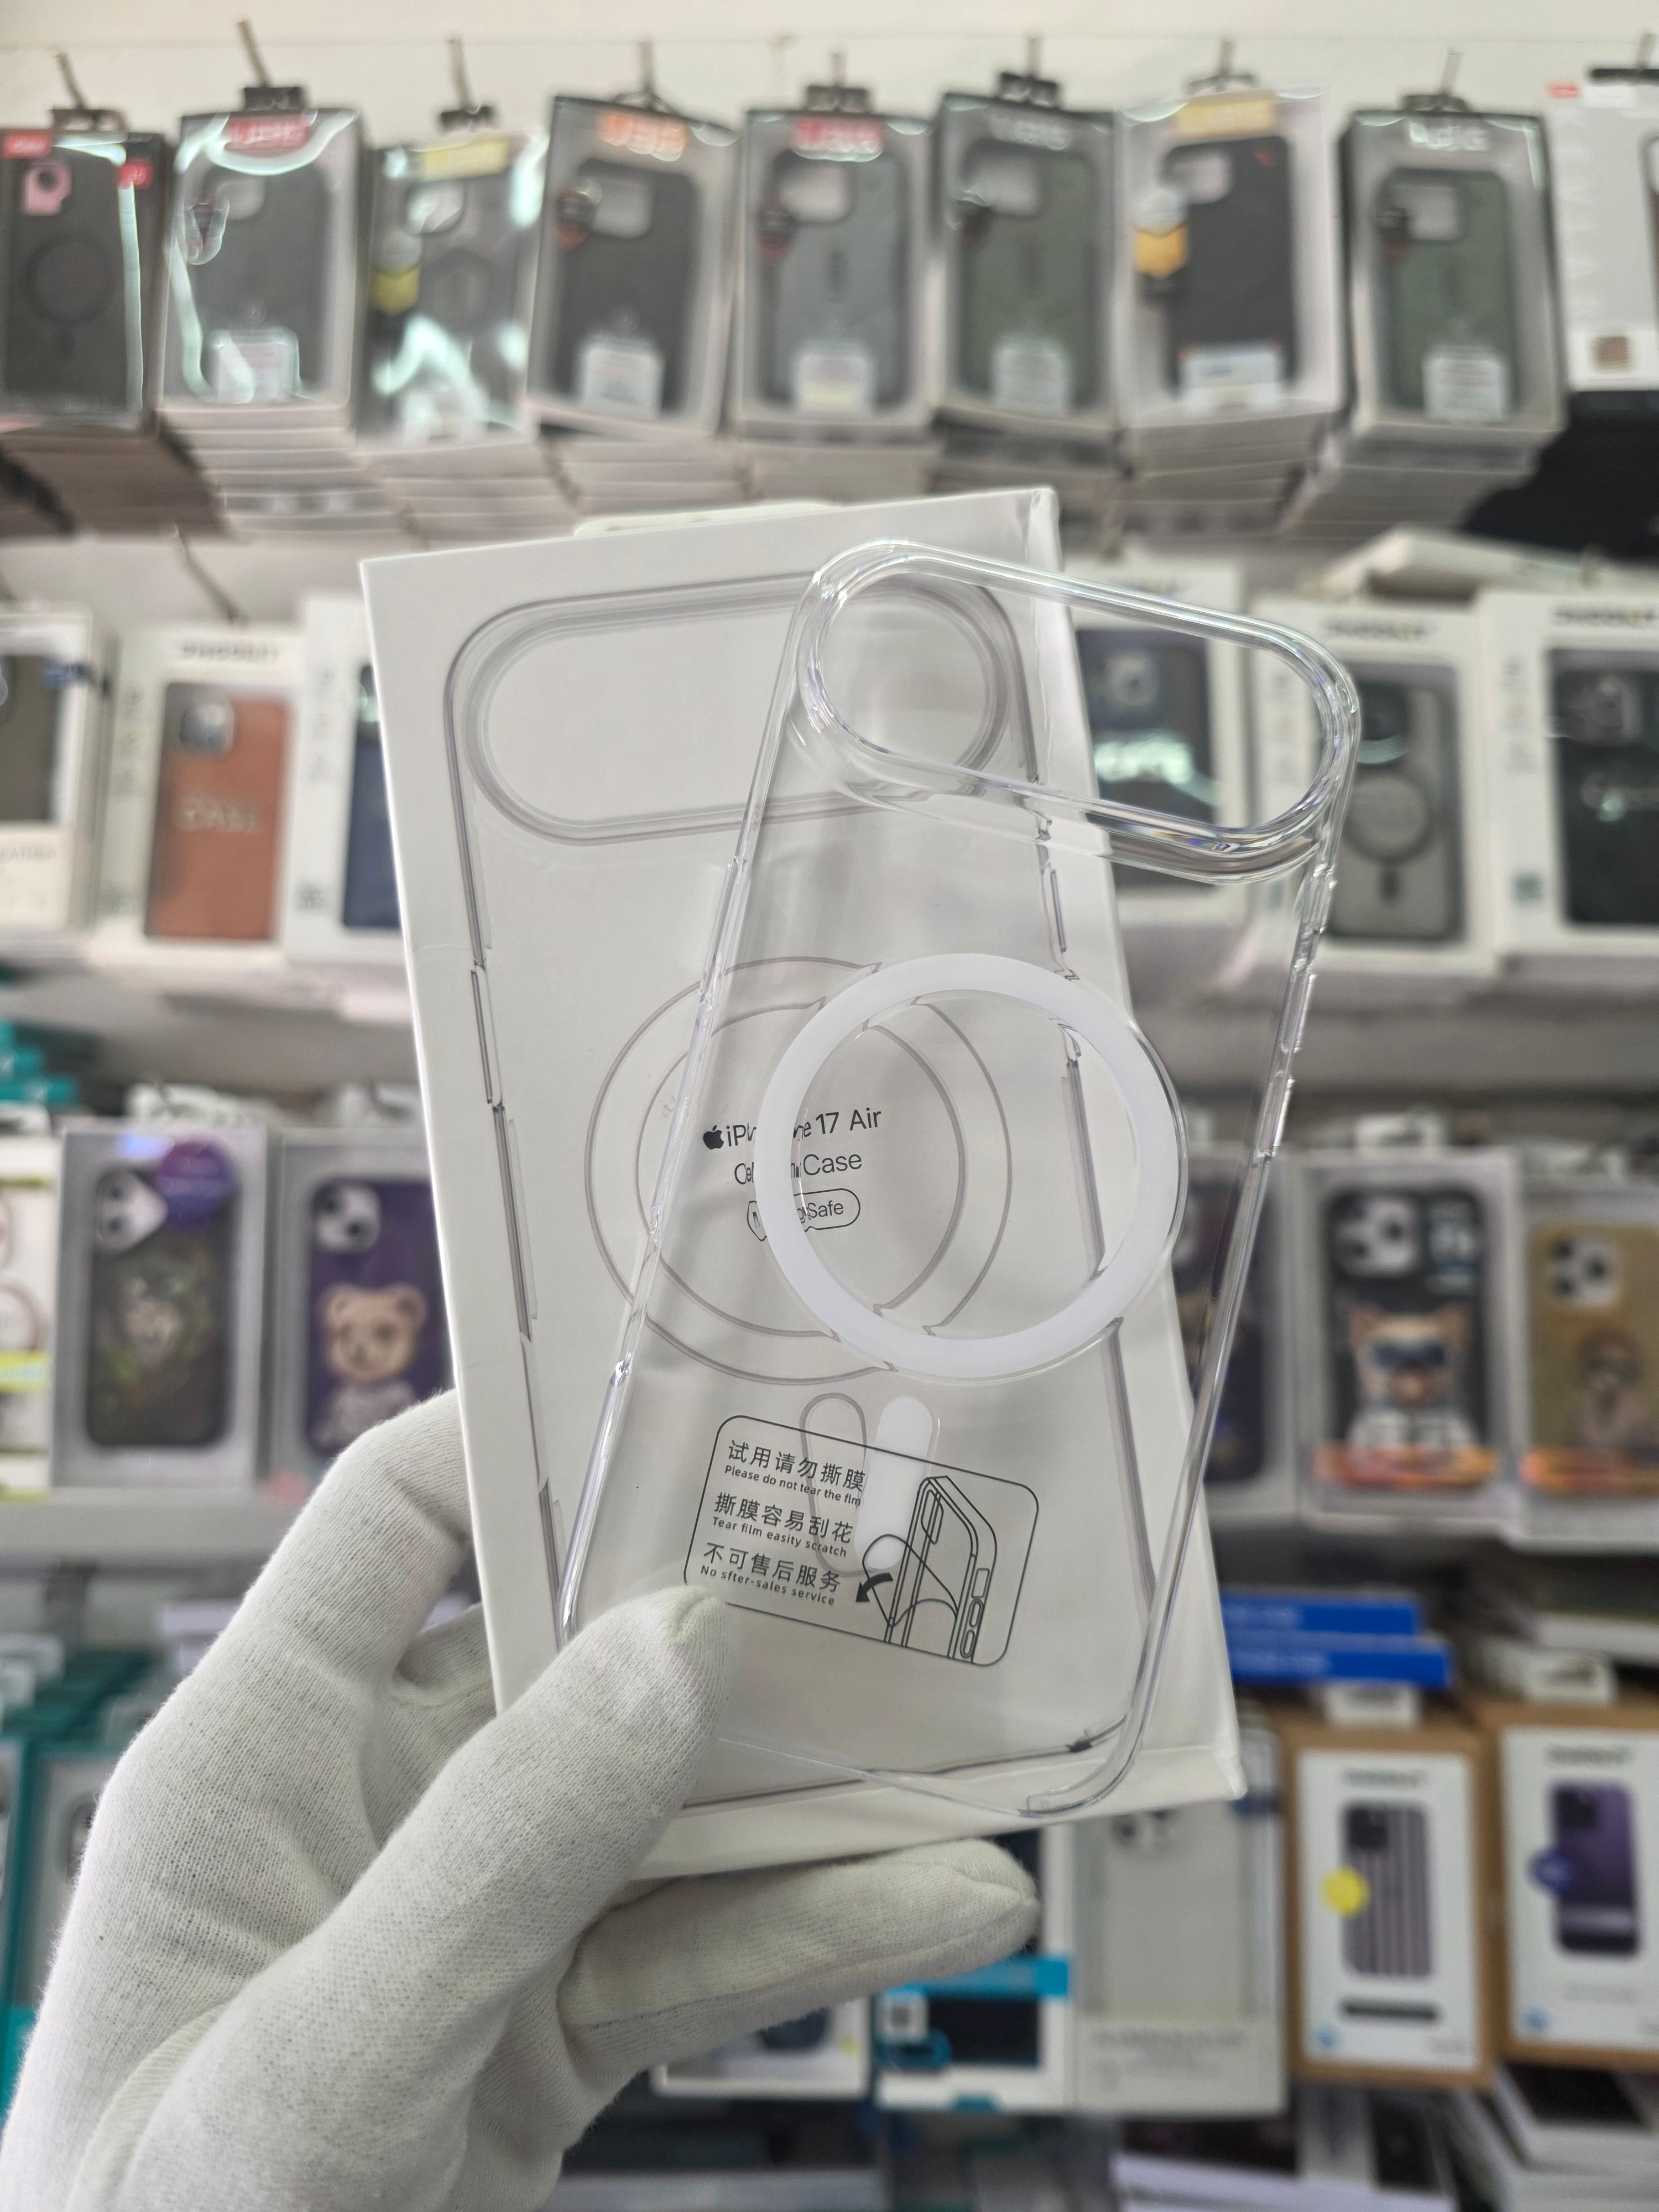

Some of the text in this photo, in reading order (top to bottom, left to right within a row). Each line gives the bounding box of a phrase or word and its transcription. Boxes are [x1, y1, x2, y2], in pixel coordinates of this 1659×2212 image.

[816, 1112, 839, 1134] 17
[849, 1107, 881, 1131] Air
[803, 1154, 862, 1175] Case
[725, 1465, 759, 1481] Please
[763, 1473, 777, 1485] do
[779, 1479, 797, 1490] not
[800, 1483, 822, 1495] tear
[824, 1489, 842, 1501] the
[728, 1439, 866, 1492] 试用请勿撕膜
[713, 1516, 737, 1530] Tear
[742, 1522, 763, 1537] film
[805, 1540, 847, 1557] scratch
[714, 1492, 853, 1543] 撕膜容易刮花
[701, 1565, 717, 1577] No
[791, 1588, 835, 1605] service
[703, 1542, 841, 1593] 不可售后服务
